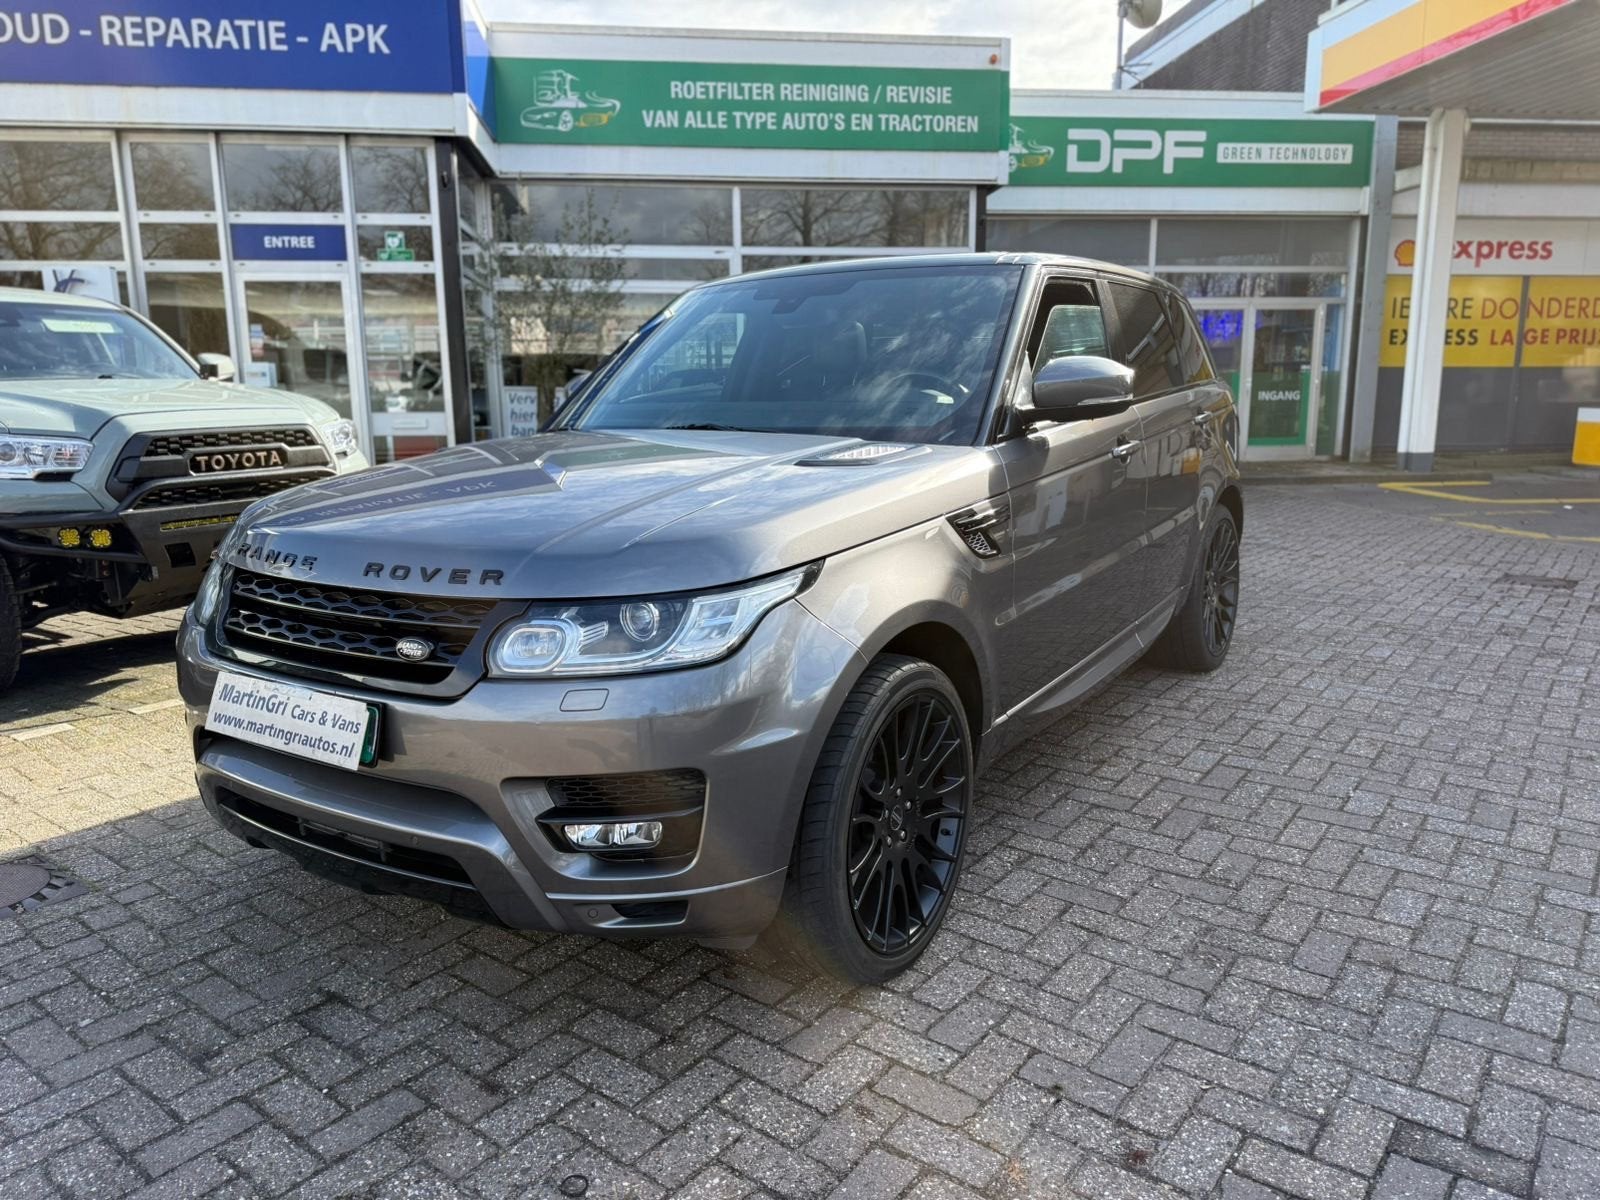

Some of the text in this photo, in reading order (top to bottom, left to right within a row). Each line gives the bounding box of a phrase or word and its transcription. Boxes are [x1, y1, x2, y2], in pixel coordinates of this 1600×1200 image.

[100, 15, 288, 51] REPARATIE
[320, 22, 391, 54] APK
[670, 80, 775, 101] ROETFILTER
[780, 83, 869, 103] REINIGING
[886, 85, 953, 104] REVISIE
[642, 110, 979, 133] VAN ALLE TYPE AUTO'S EN TRACTOREN
[1066, 128, 1208, 174] DPF
[1222, 146, 1349, 161] GREEN TECHNOLOGY
[263, 235, 316, 249] ENTREE
[1452, 239, 1554, 268] xpress
[1391, 296, 1475, 319] IERE
[1556, 328, 1600, 346] PRIJ
[1257, 390, 1301, 401] INGANG
[196, 450, 282, 472] TOYOTA
[237, 542, 505, 586] RANGE ROVER
[218, 683, 361, 735] MartinGri Cars & Vans
[213, 711, 356, 758] www.martingriautos.nl
